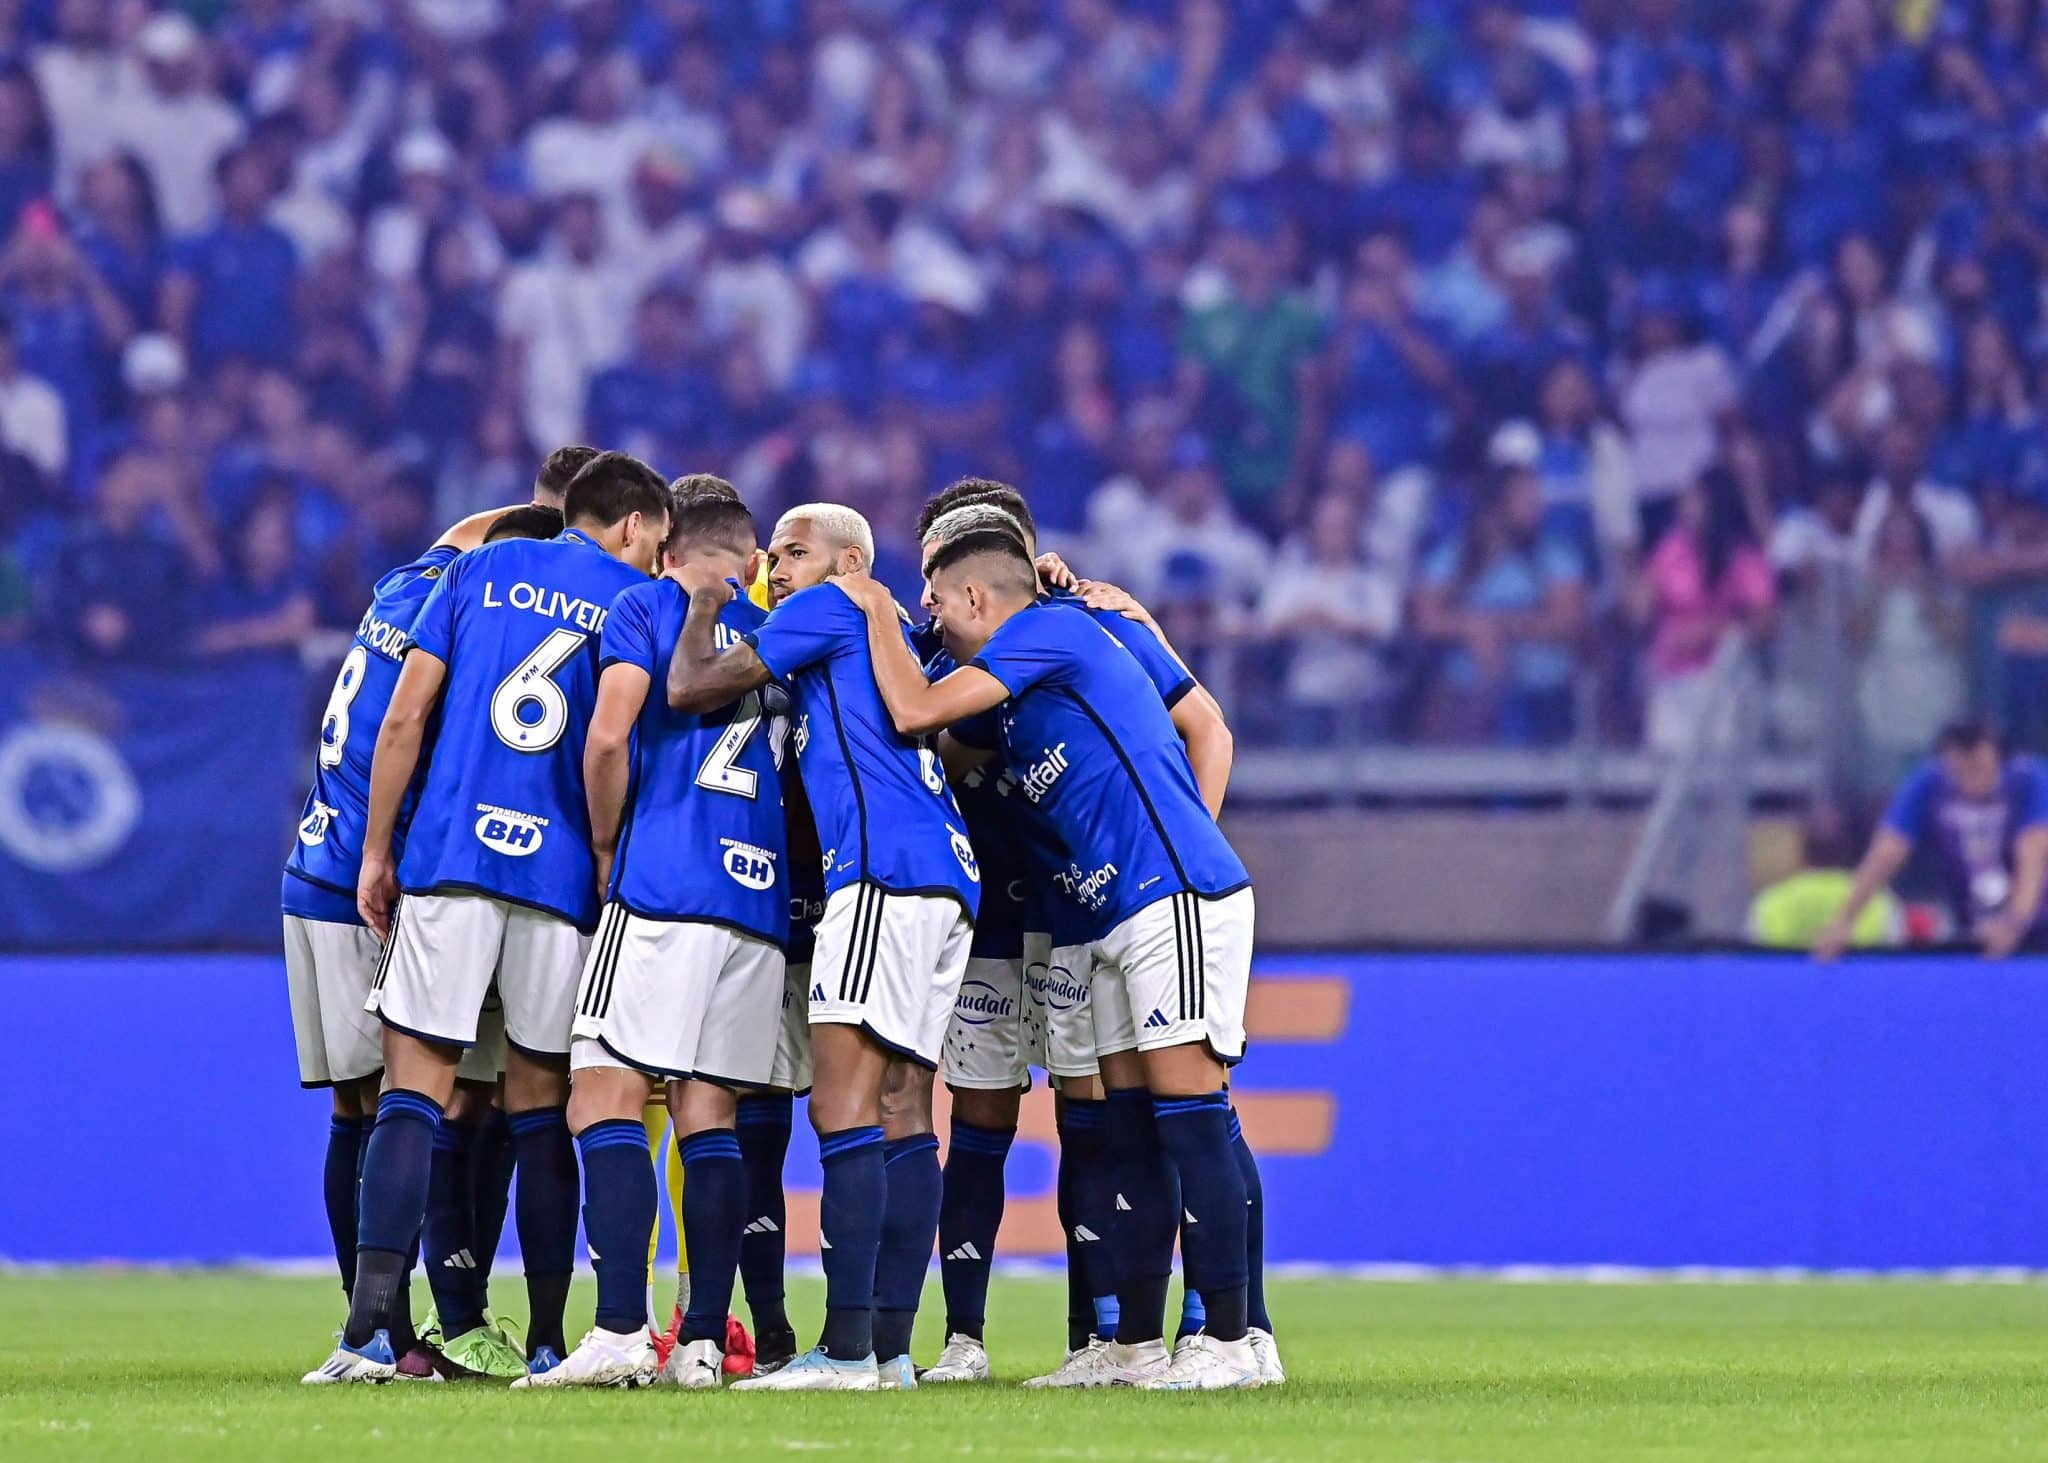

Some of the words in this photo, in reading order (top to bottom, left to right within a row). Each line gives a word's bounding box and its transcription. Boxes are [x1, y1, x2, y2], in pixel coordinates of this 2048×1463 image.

[483, 581, 503, 608] L.
[365, 616, 407, 662] MOUR
[490, 628, 588, 752] 6
[319, 645, 367, 770] 8
[1023, 742, 1069, 803] etfair
[482, 818, 536, 849] BH
[730, 853, 769, 883] BH
[954, 993, 1014, 1016] audali
[1047, 978, 1089, 1002] udali
